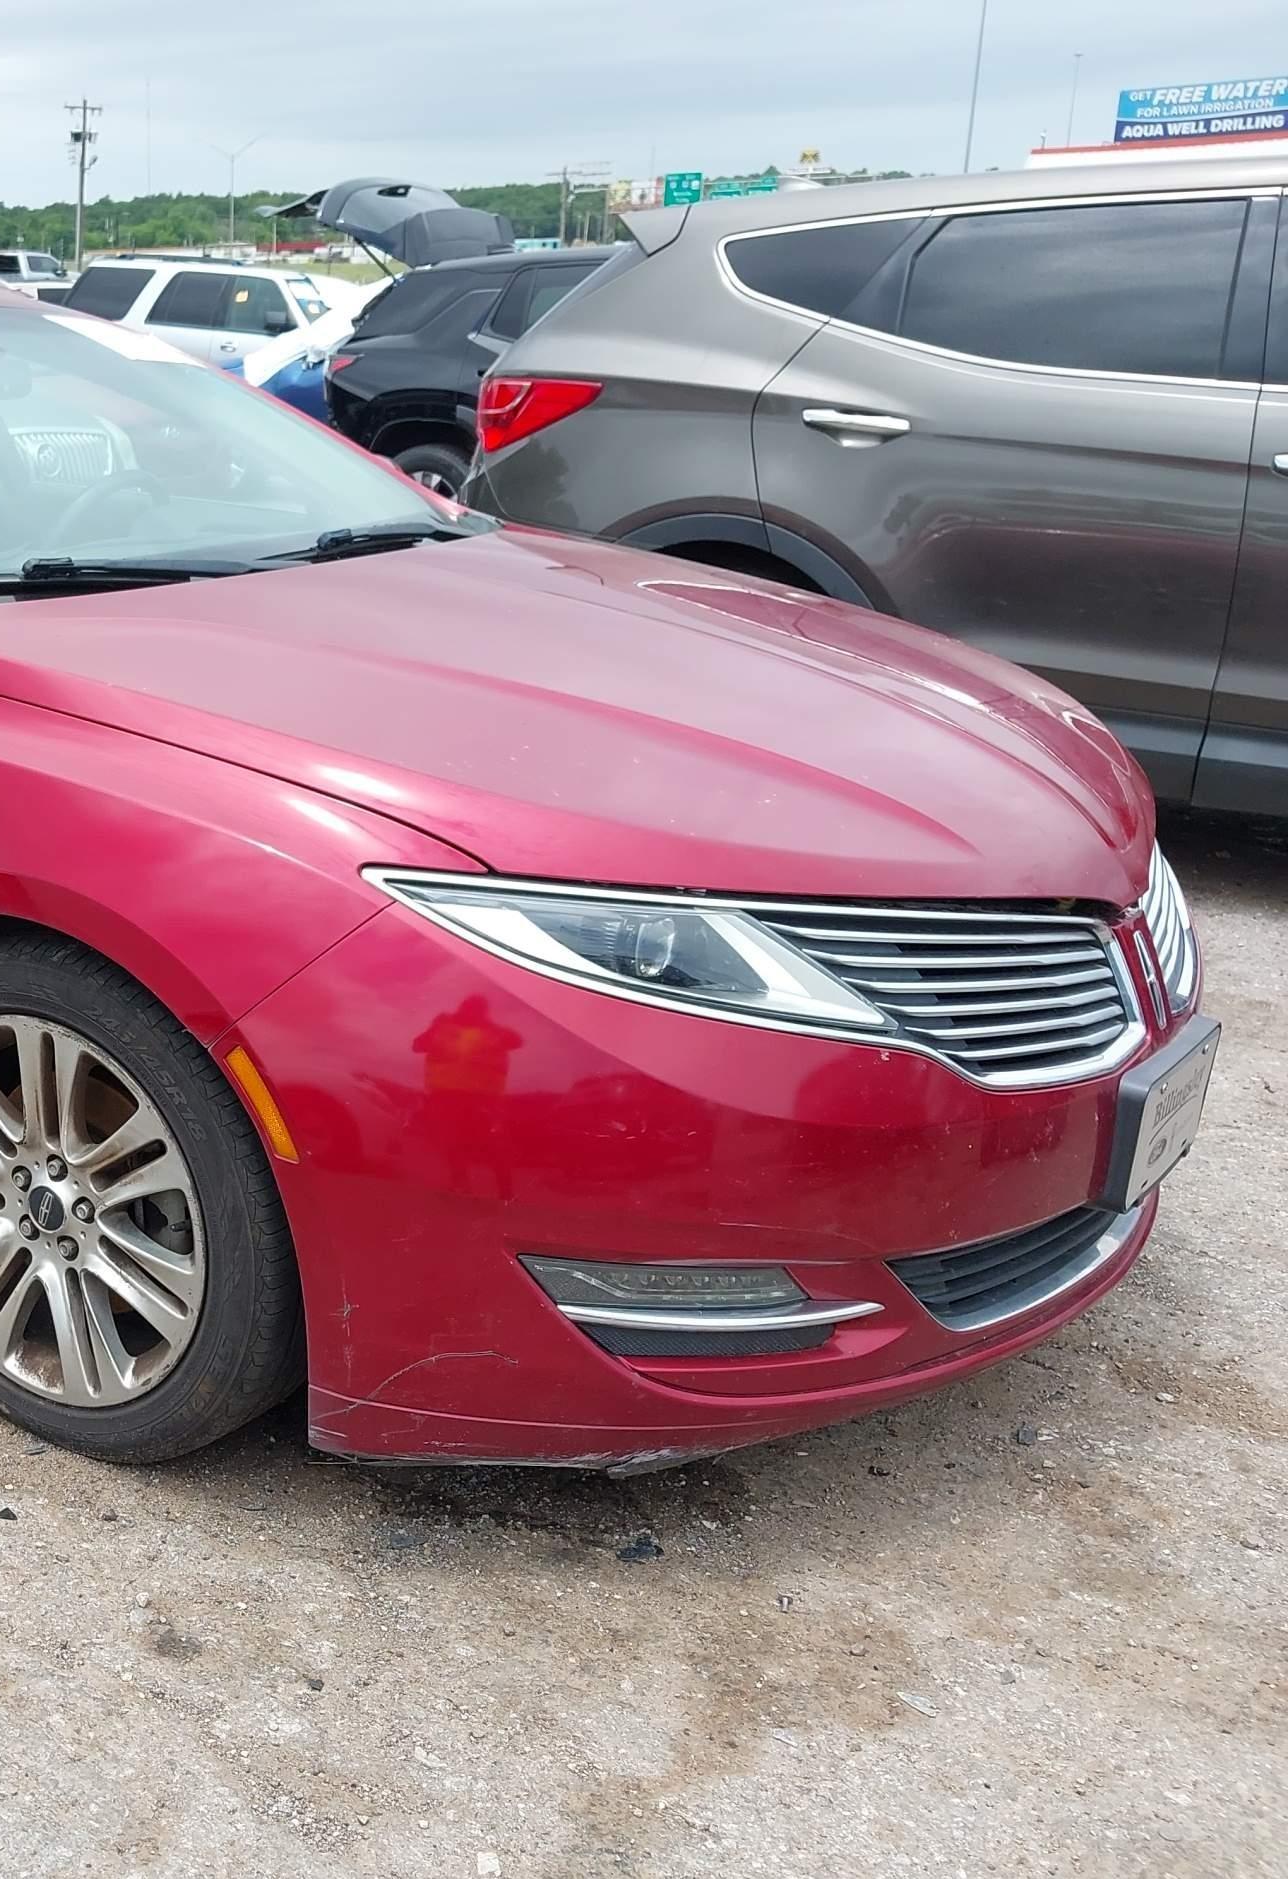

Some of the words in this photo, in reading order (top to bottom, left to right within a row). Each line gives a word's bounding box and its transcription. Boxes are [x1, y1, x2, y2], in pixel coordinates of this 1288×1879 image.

[1129, 91, 1151, 102] GET
[1152, 85, 1208, 105] FREE
[1211, 78, 1288, 101] WATER
[1136, 107, 1161, 118] FOR
[1163, 104, 1199, 116] LAWN
[1201, 97, 1274, 114] IRRIGATION
[1122, 123, 1164, 138] AQUA
[1167, 121, 1207, 135] WELL
[1210, 115, 1285, 132] DRILLING
